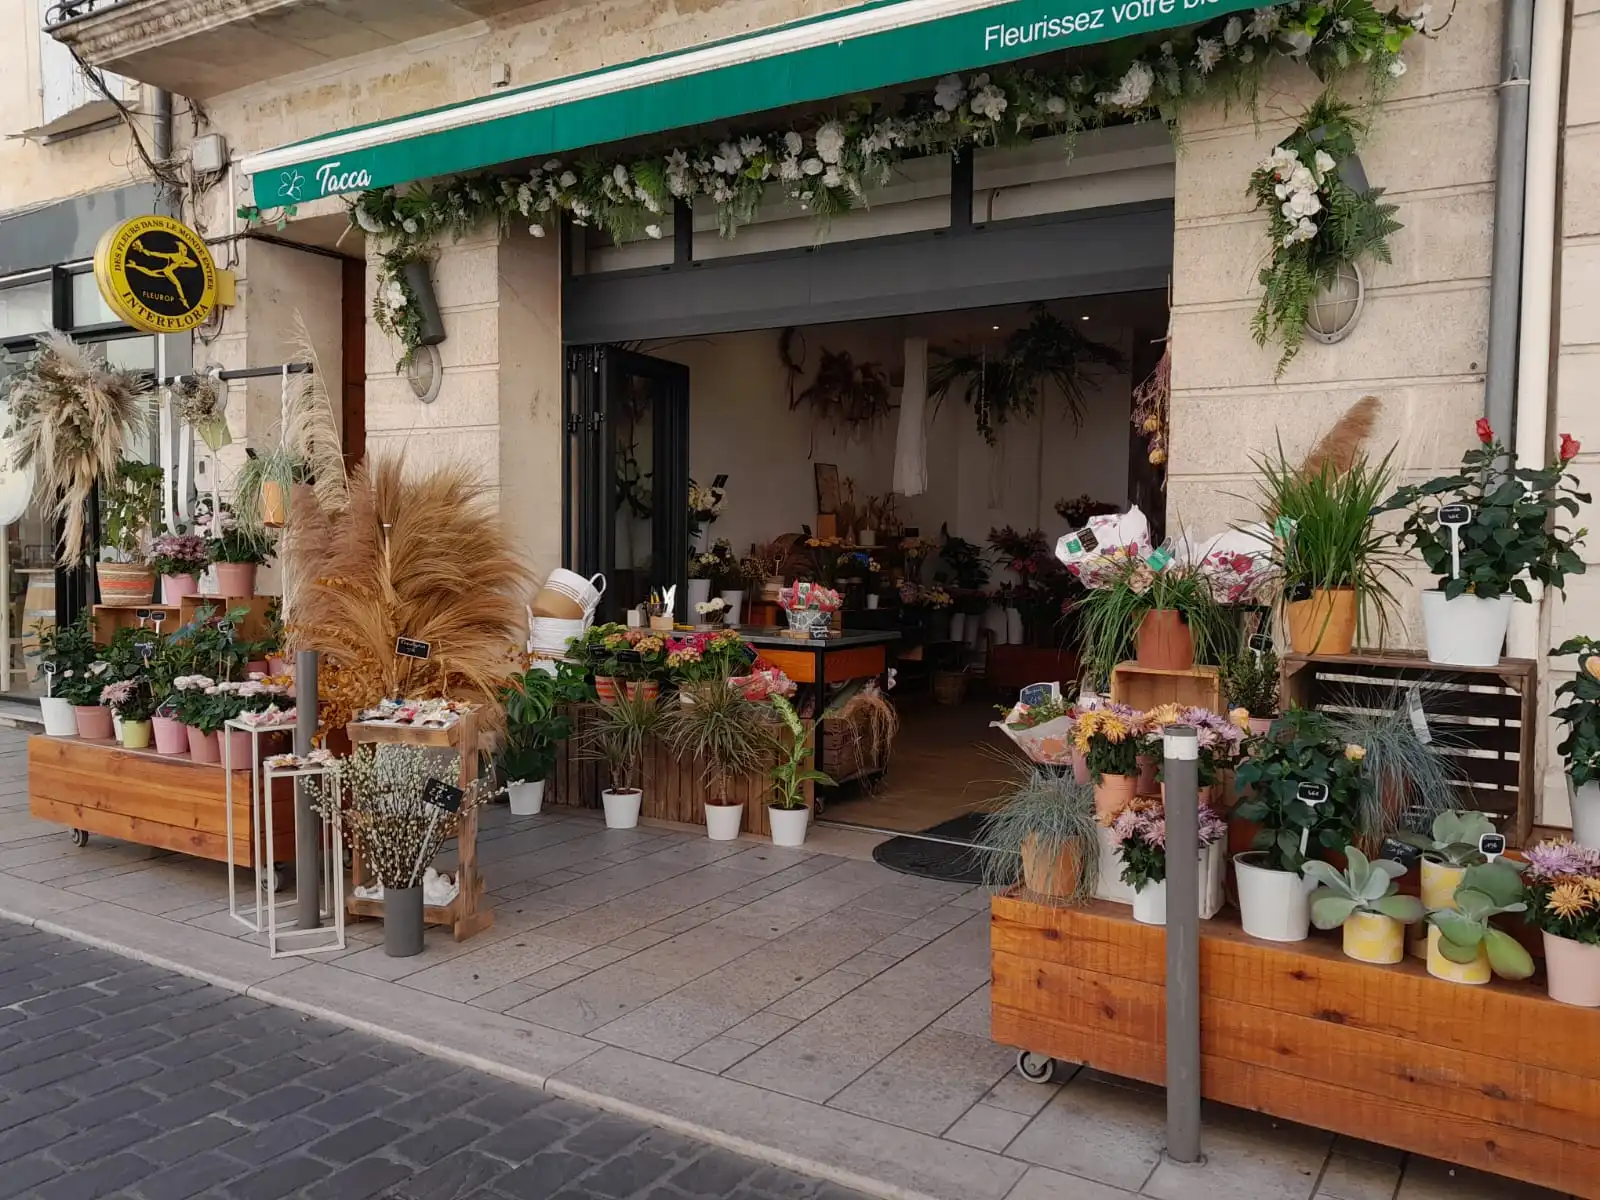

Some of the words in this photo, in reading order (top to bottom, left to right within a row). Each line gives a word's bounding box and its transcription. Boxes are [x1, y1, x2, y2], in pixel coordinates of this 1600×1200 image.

[985, 9, 1105, 50] Fleurissez
[1111, 0, 1175, 23] votre
[316, 161, 372, 195] Tacca
[114, 253, 122, 272] DES
[118, 224, 141, 251] FLEURS
[141, 219, 164, 229] DANS
[165, 221, 177, 232] LE
[179, 228, 204, 257] MONDE
[202, 257, 214, 290] ENTIER
[122, 290, 209, 328] INTERFLORA
[142, 290, 175, 303] FLEUROP
